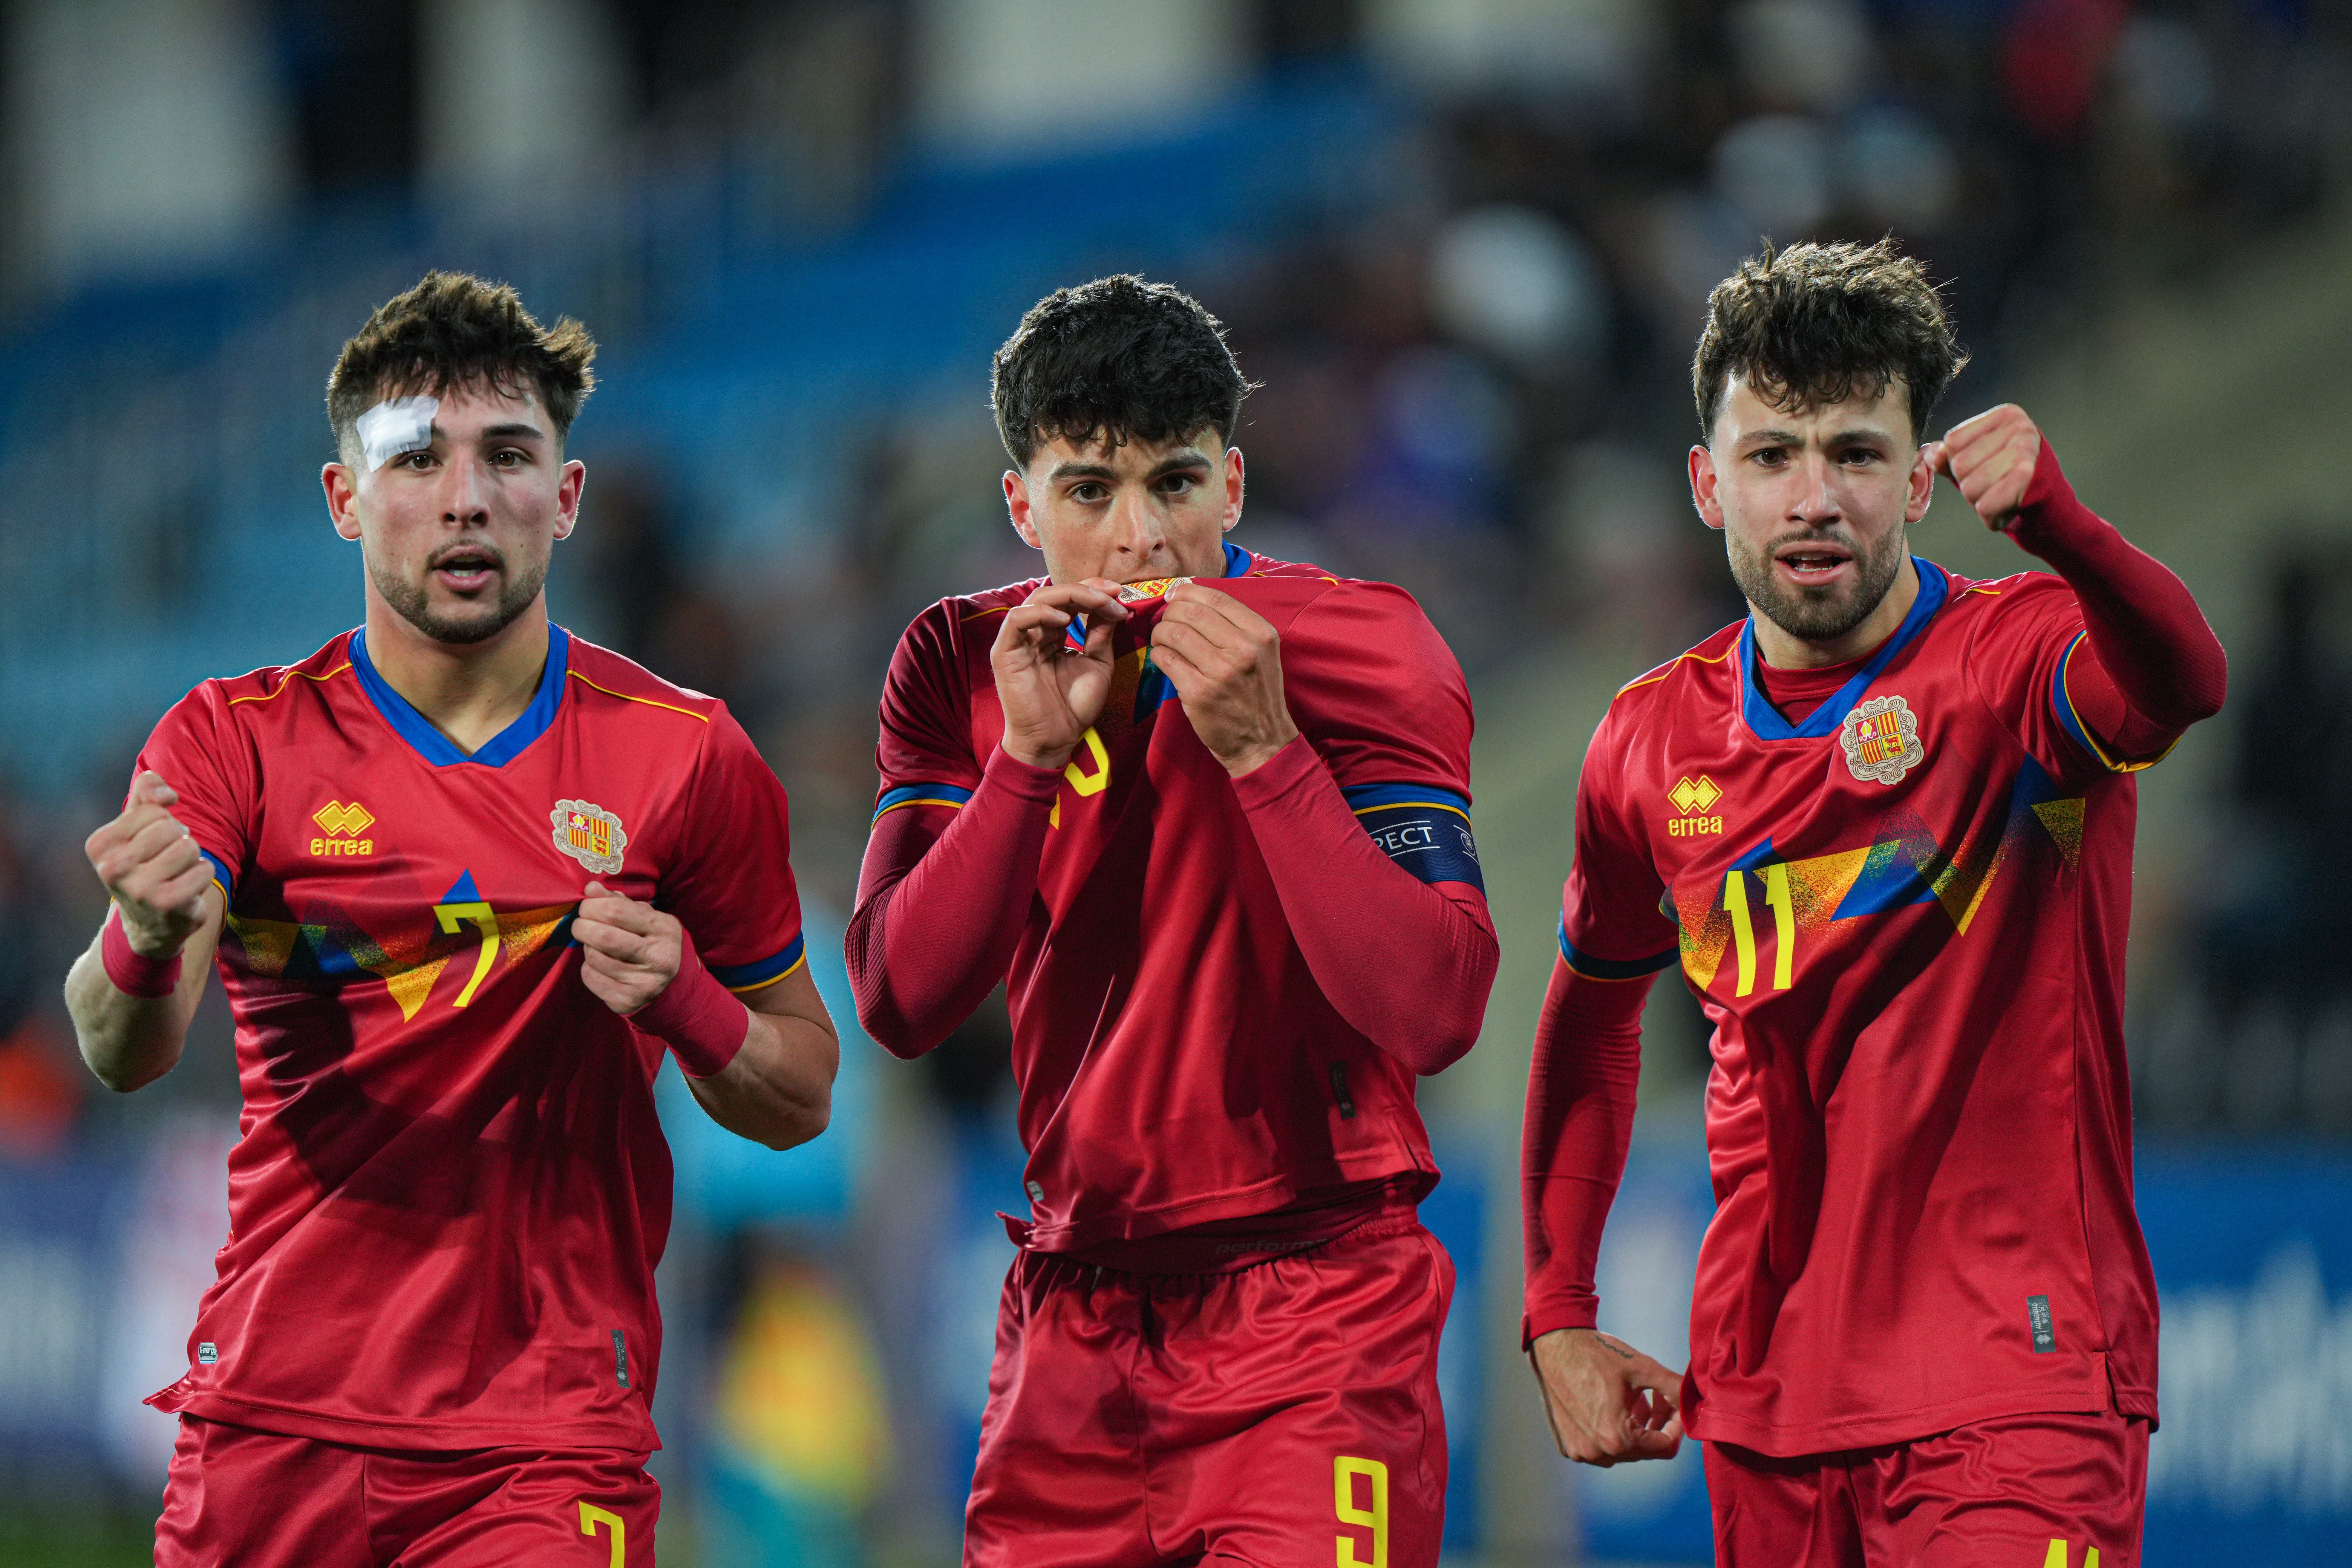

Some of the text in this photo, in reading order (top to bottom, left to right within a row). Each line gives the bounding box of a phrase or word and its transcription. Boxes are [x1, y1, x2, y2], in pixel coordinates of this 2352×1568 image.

[1894, 753, 1912, 766] FORTIOR
[433, 902, 500, 1008] 7
[1723, 863, 1795, 998] 11
[578, 1500, 625, 1568] 7
[1334, 1456, 1388, 1568] 9
